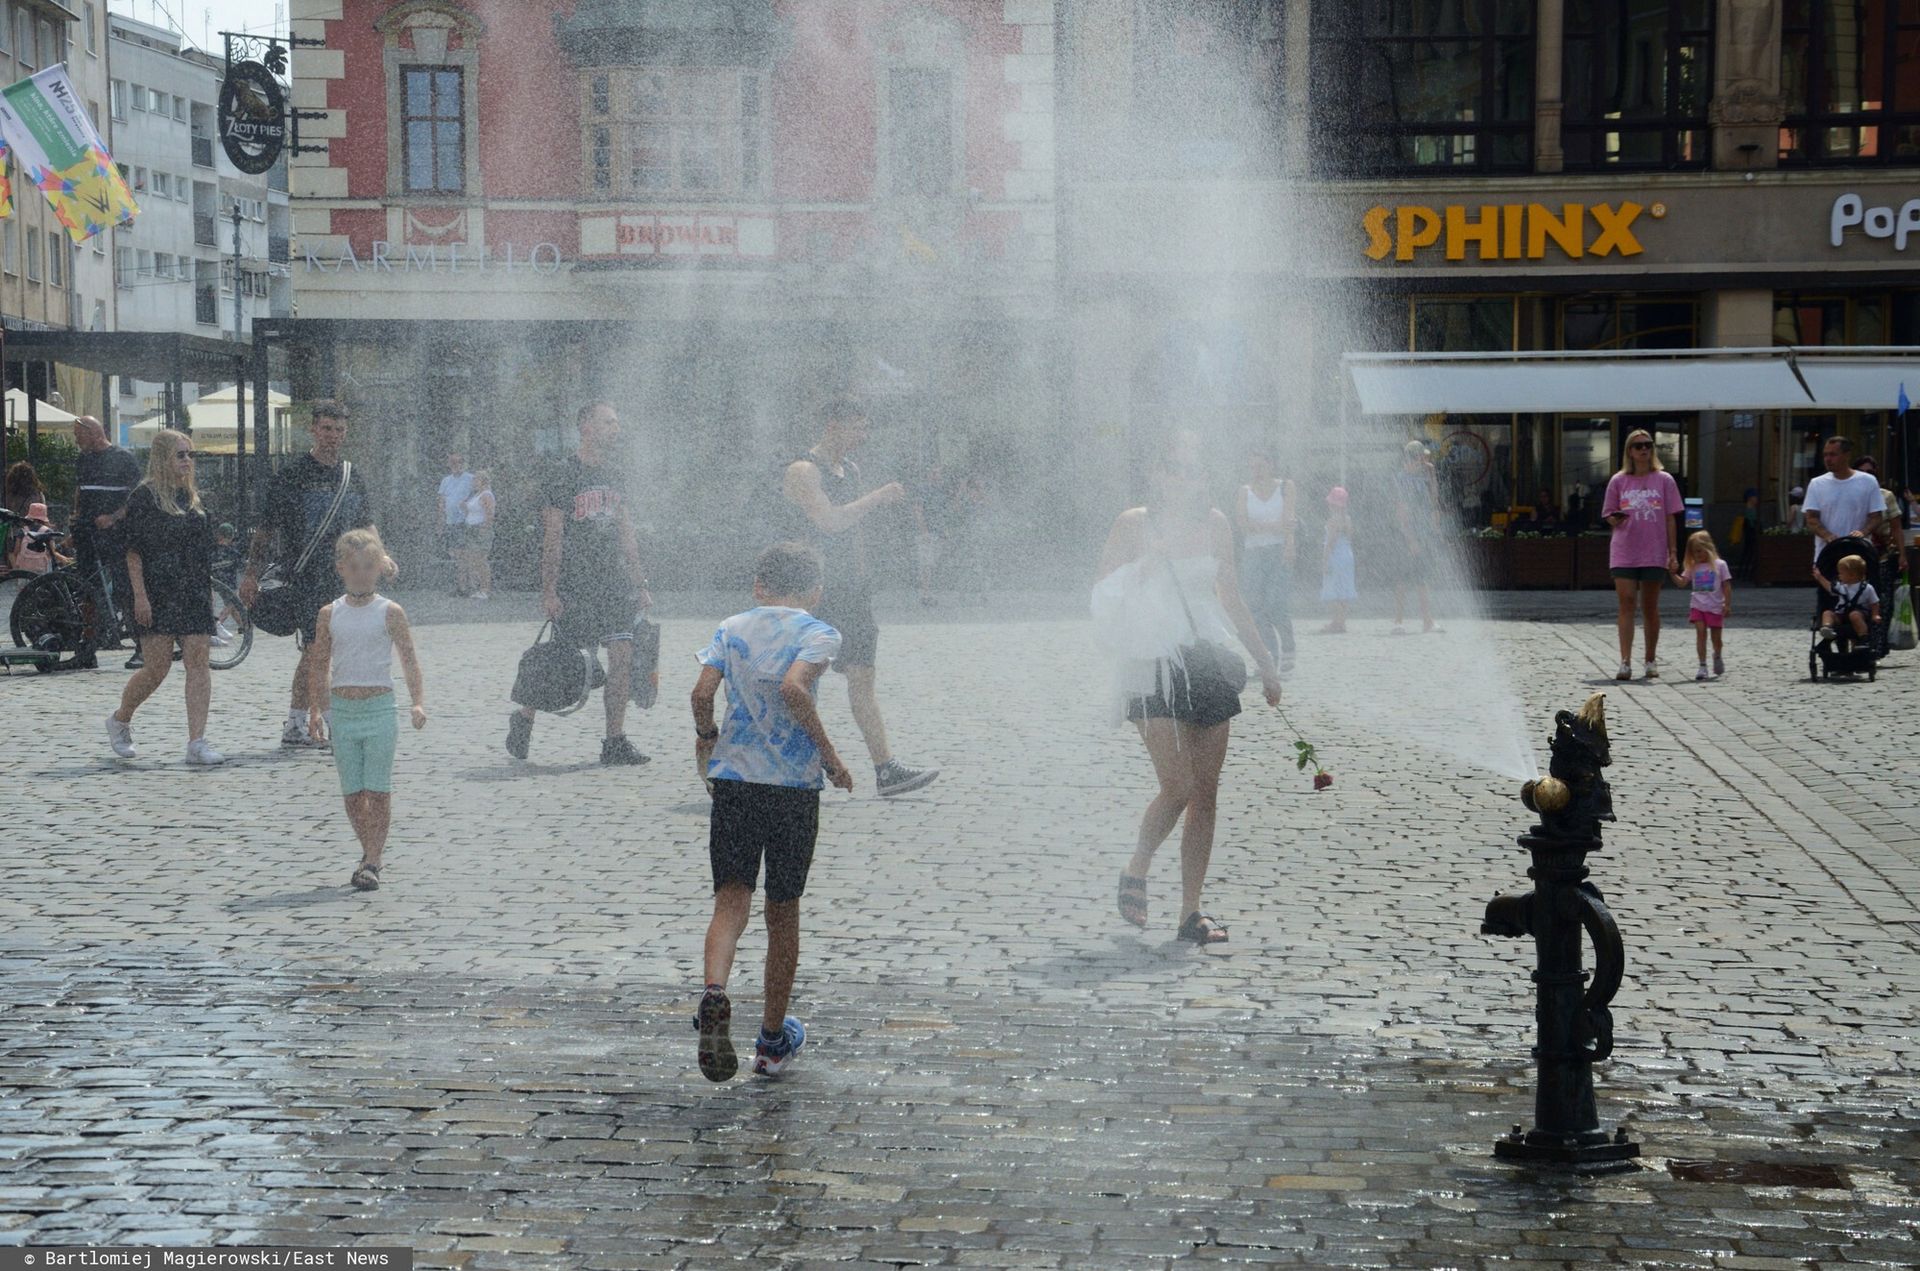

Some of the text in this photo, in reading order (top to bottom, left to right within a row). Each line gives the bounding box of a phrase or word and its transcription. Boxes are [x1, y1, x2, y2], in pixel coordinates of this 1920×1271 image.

[225, 116, 282, 141] ZŁOTY PIES
[1362, 201, 1645, 261] SPHINX
[304, 240, 562, 274] KARMELLO
